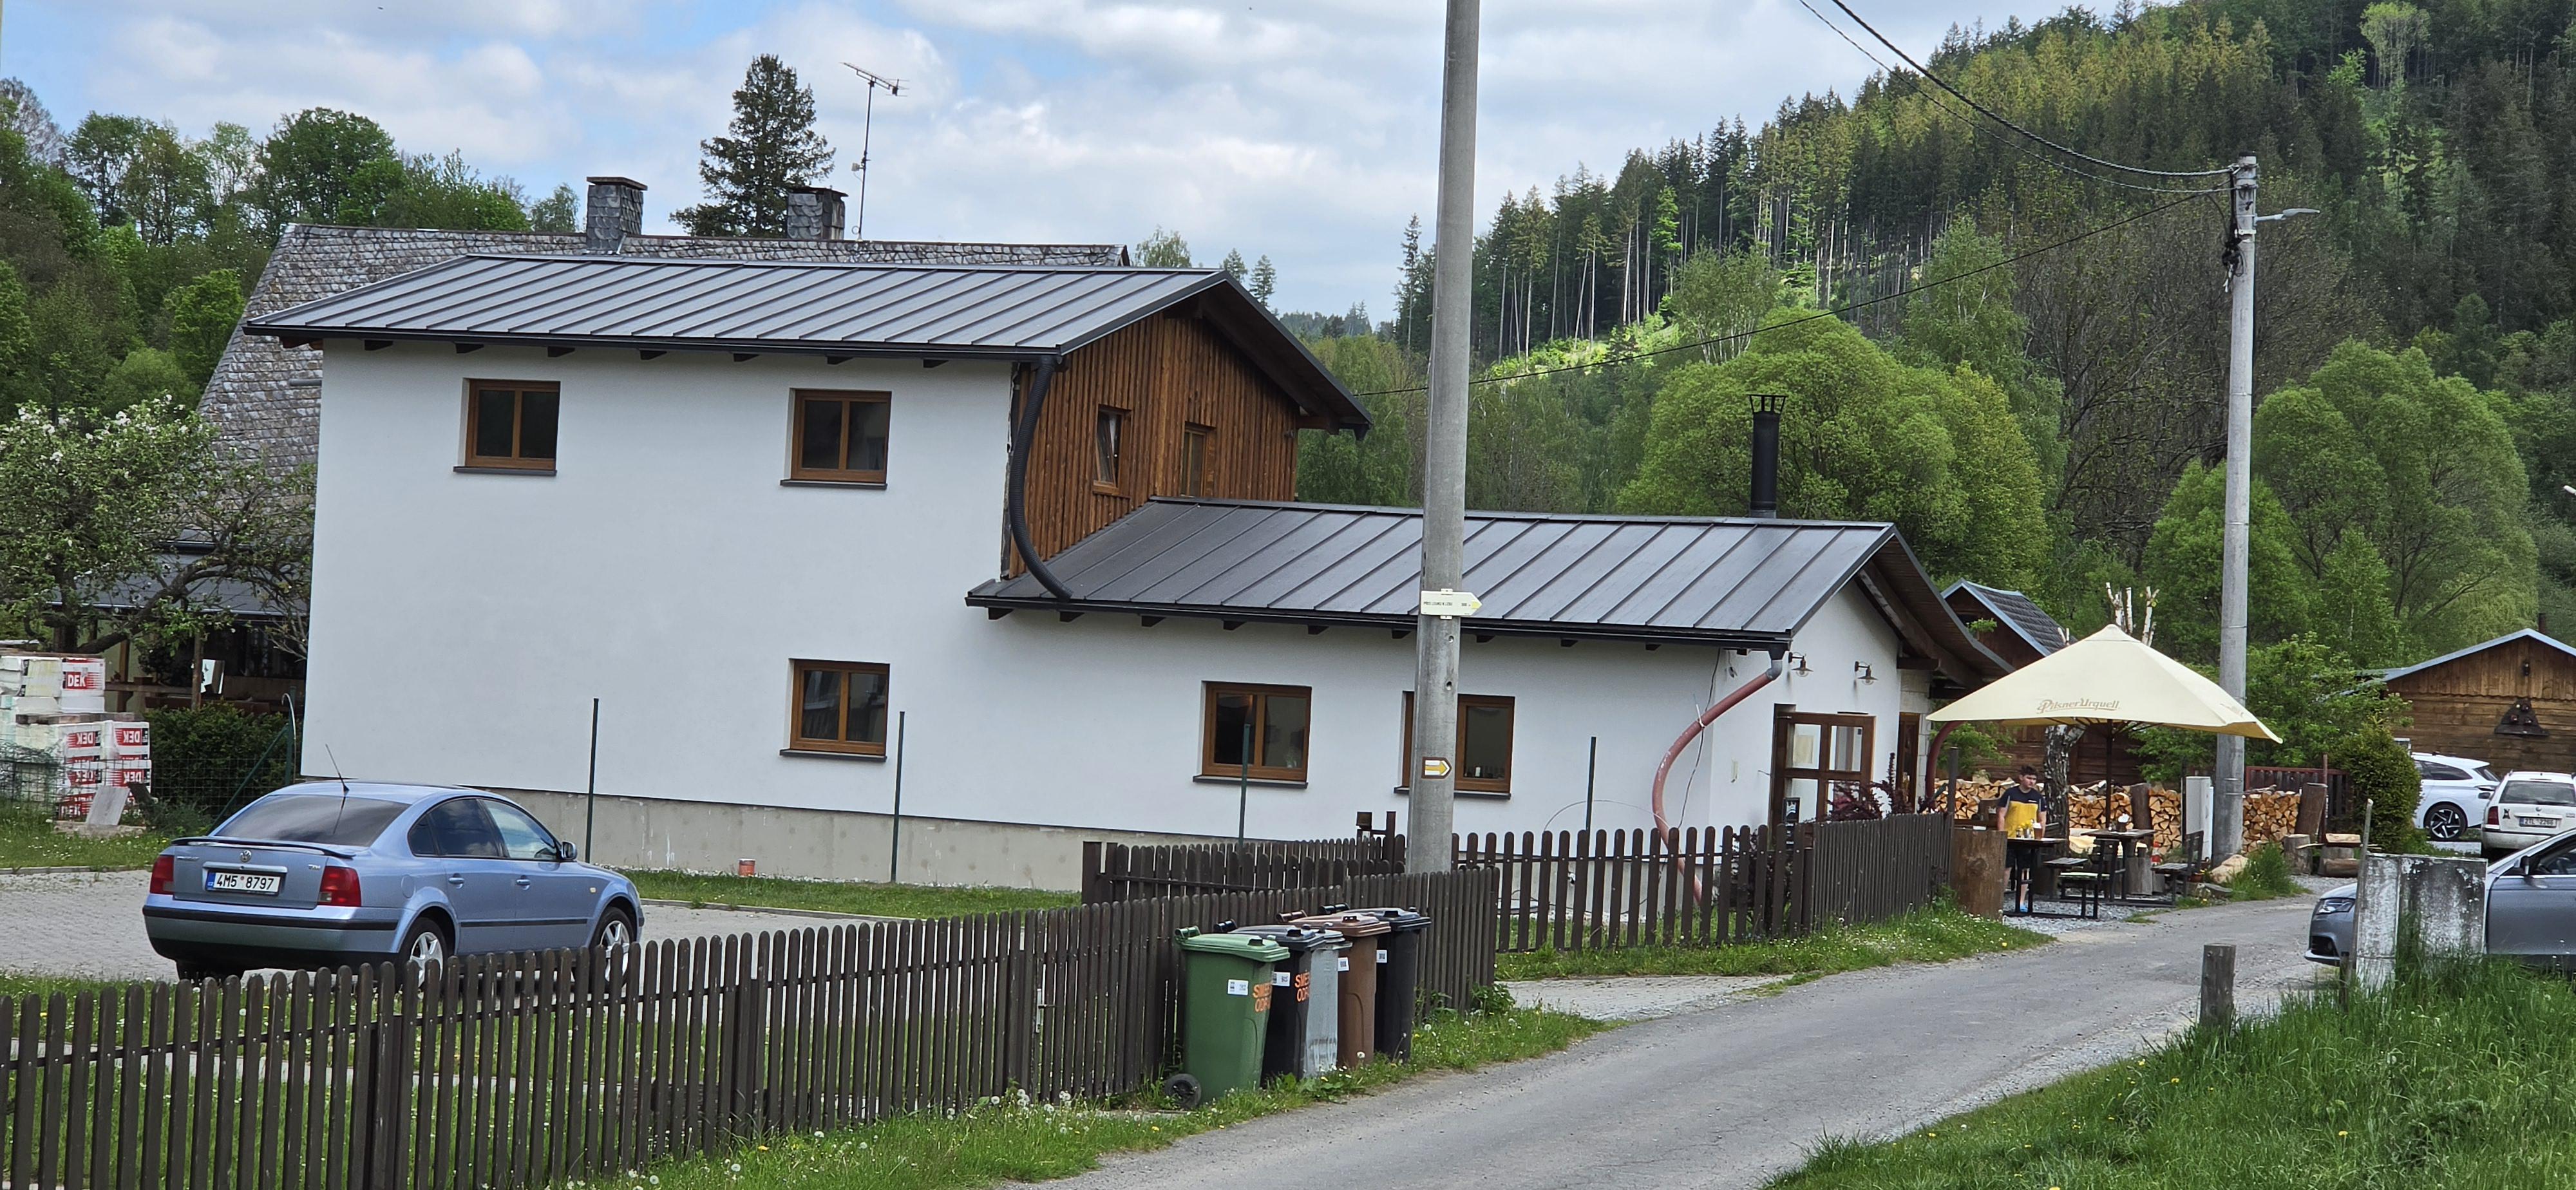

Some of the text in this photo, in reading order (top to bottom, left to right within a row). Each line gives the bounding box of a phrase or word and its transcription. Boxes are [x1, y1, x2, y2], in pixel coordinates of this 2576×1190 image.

[68, 674, 86, 687] DEK
[2036, 698, 2120, 714] Pilsner Urquell
[77, 733, 93, 744] DEK
[123, 731, 140, 742] DEK
[123, 771, 142, 784] DEK
[216, 874, 274, 890] 4M5 8797
